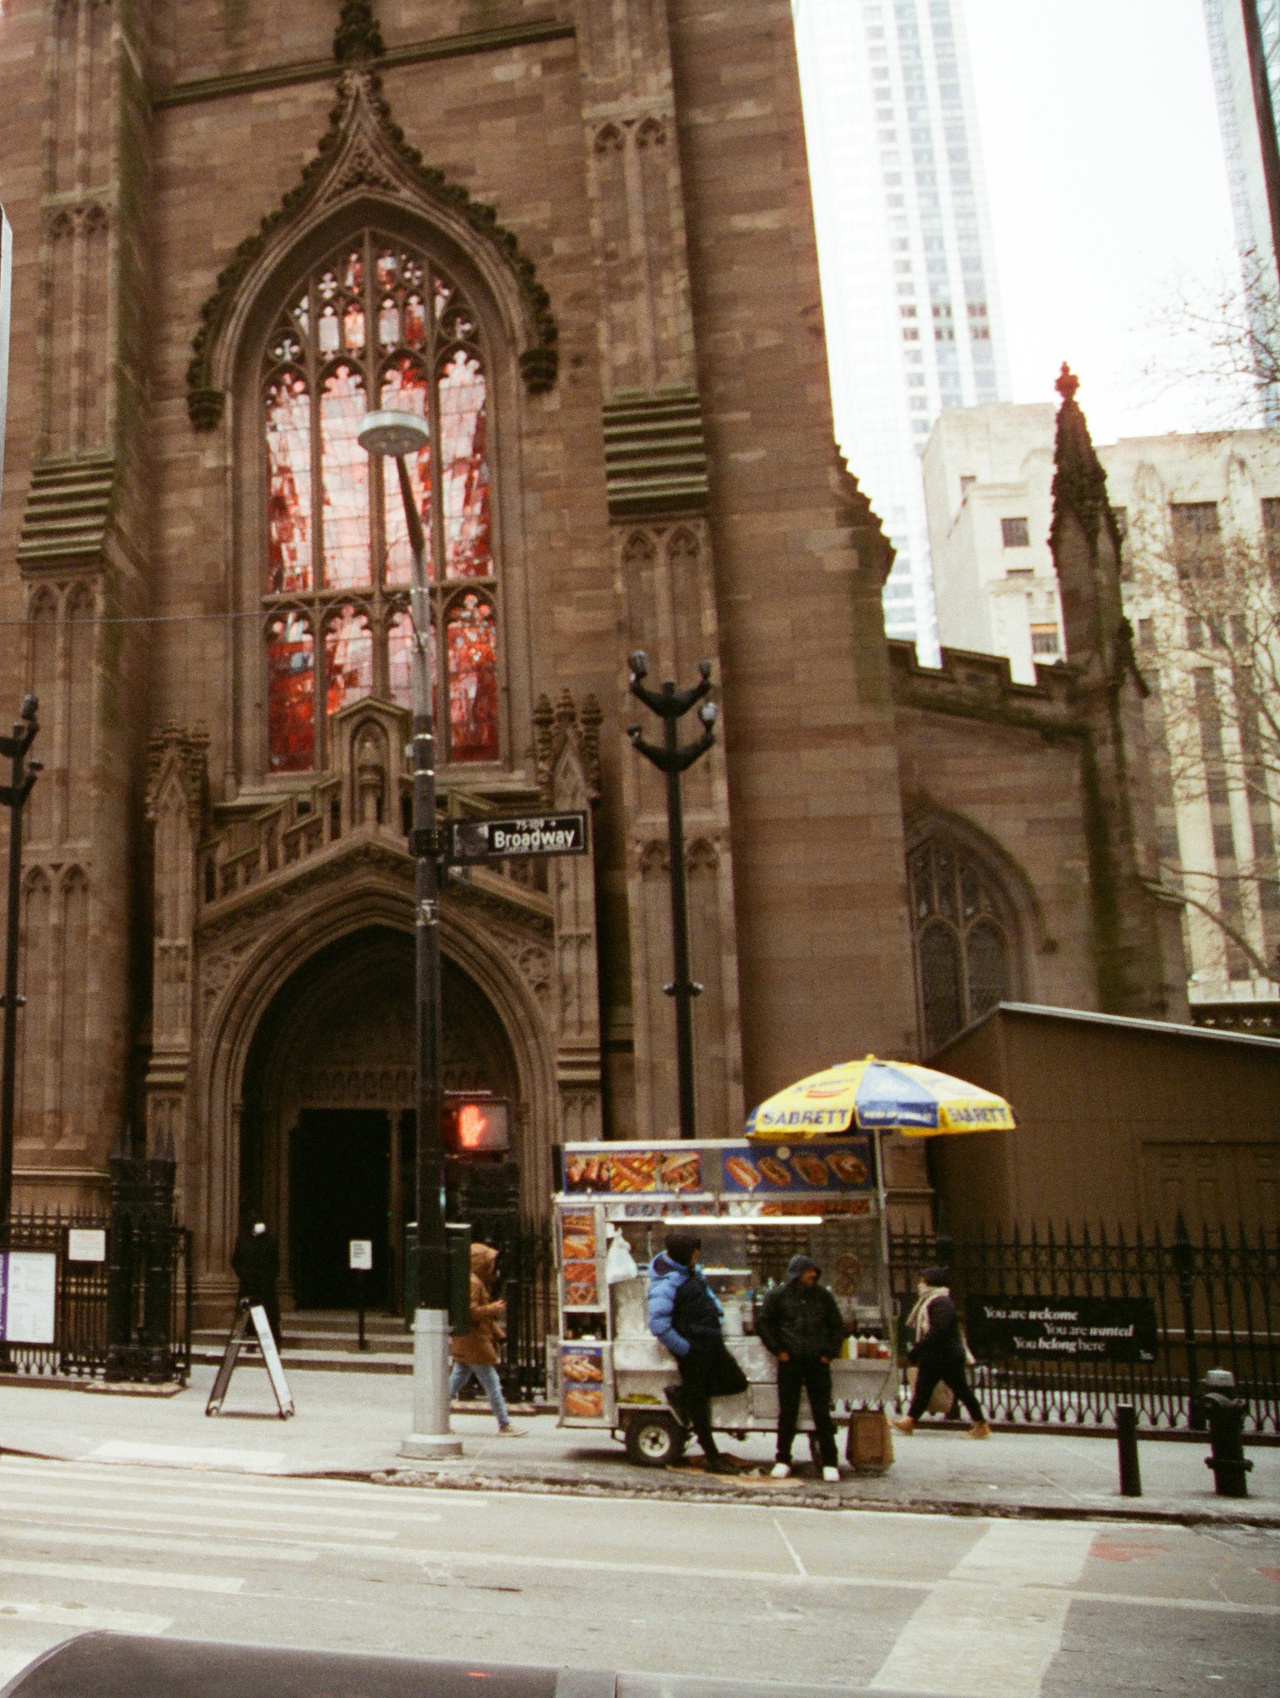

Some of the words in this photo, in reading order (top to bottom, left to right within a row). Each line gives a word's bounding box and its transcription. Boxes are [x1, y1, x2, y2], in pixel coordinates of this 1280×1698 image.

[494, 828, 575, 848] Broadway
[763, 1108, 849, 1125] SABRETT
[984, 1305, 1007, 1319] You
[1008, 1310, 1027, 1320] are
[1028, 1307, 1078, 1321] welcome
[1044, 1322, 1067, 1336] You
[1069, 1326, 1088, 1336] are
[1089, 1324, 1135, 1337] wanted
[1013, 1336, 1037, 1349] You
[1038, 1336, 1077, 1353] belong
[1077, 1338, 1106, 1351] here
